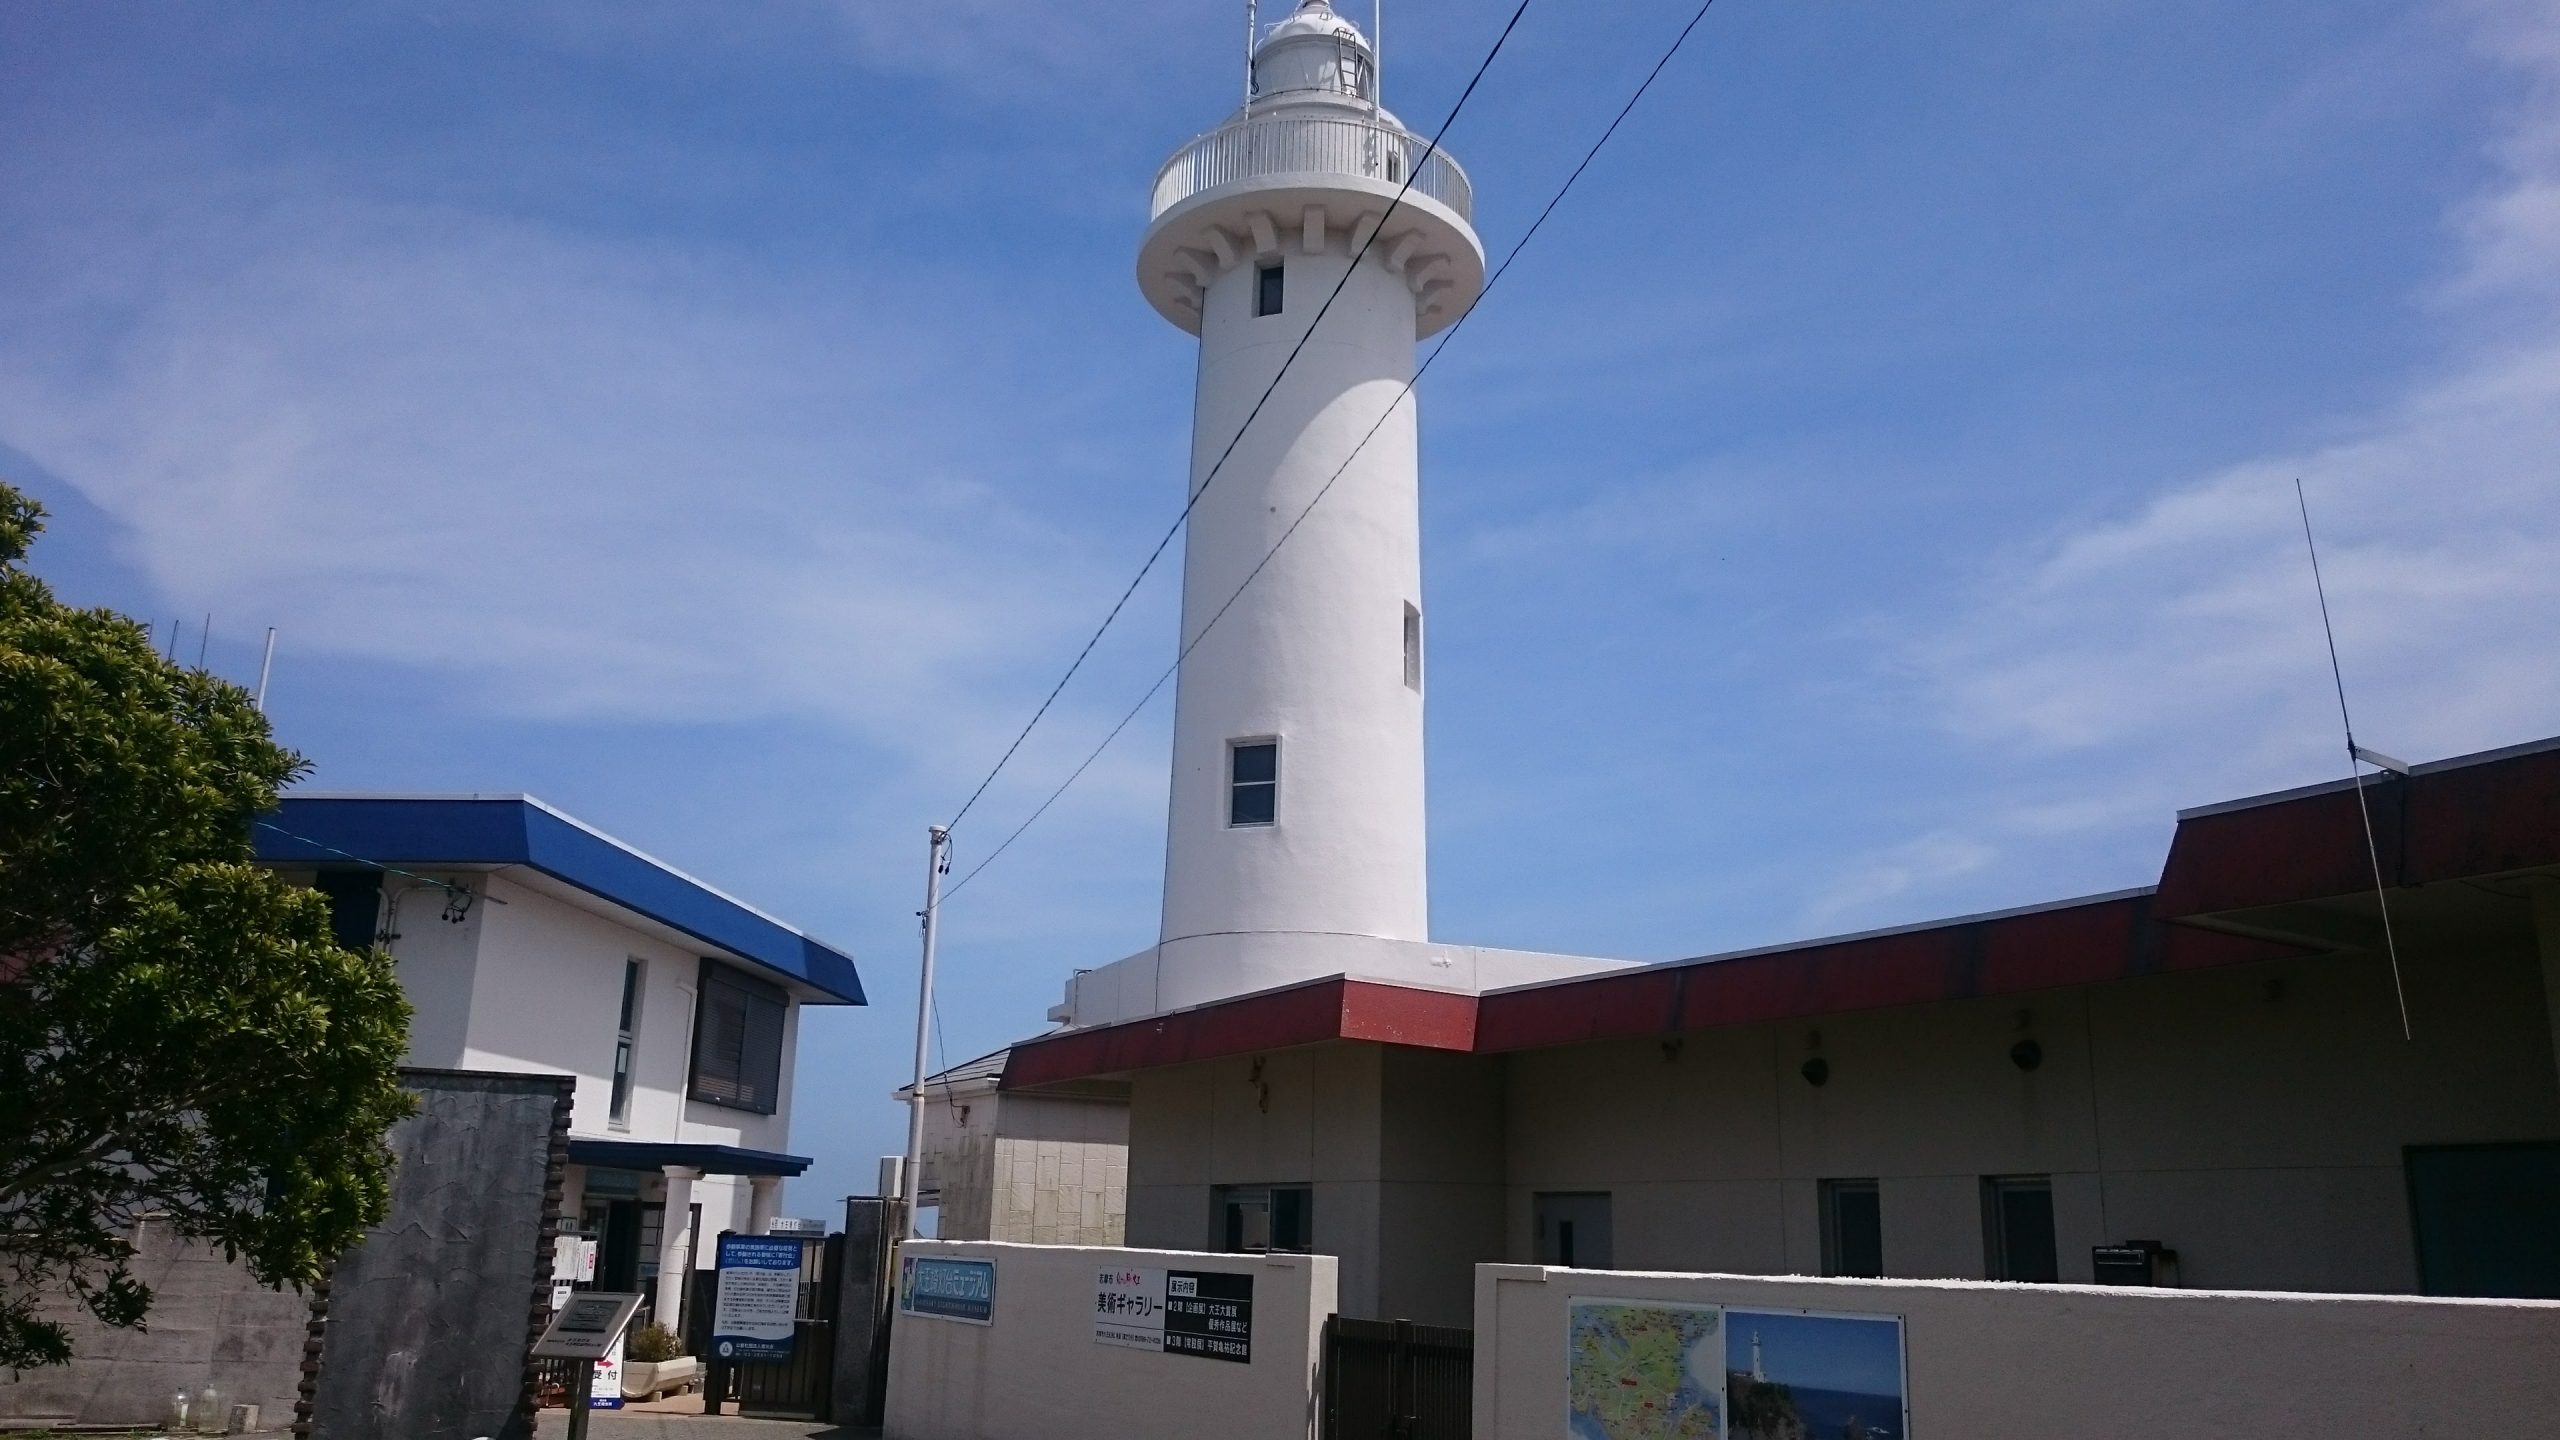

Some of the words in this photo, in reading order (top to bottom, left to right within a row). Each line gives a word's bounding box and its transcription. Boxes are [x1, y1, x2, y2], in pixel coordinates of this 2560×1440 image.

[1171, 1280, 1195, 1294] 展示内容
[1097, 1292, 1163, 1317] 美術ギャラリー
[1208, 1303, 1238, 1318] 大王大賞展
[1208, 1318, 1248, 1334] 優秀作品展など
